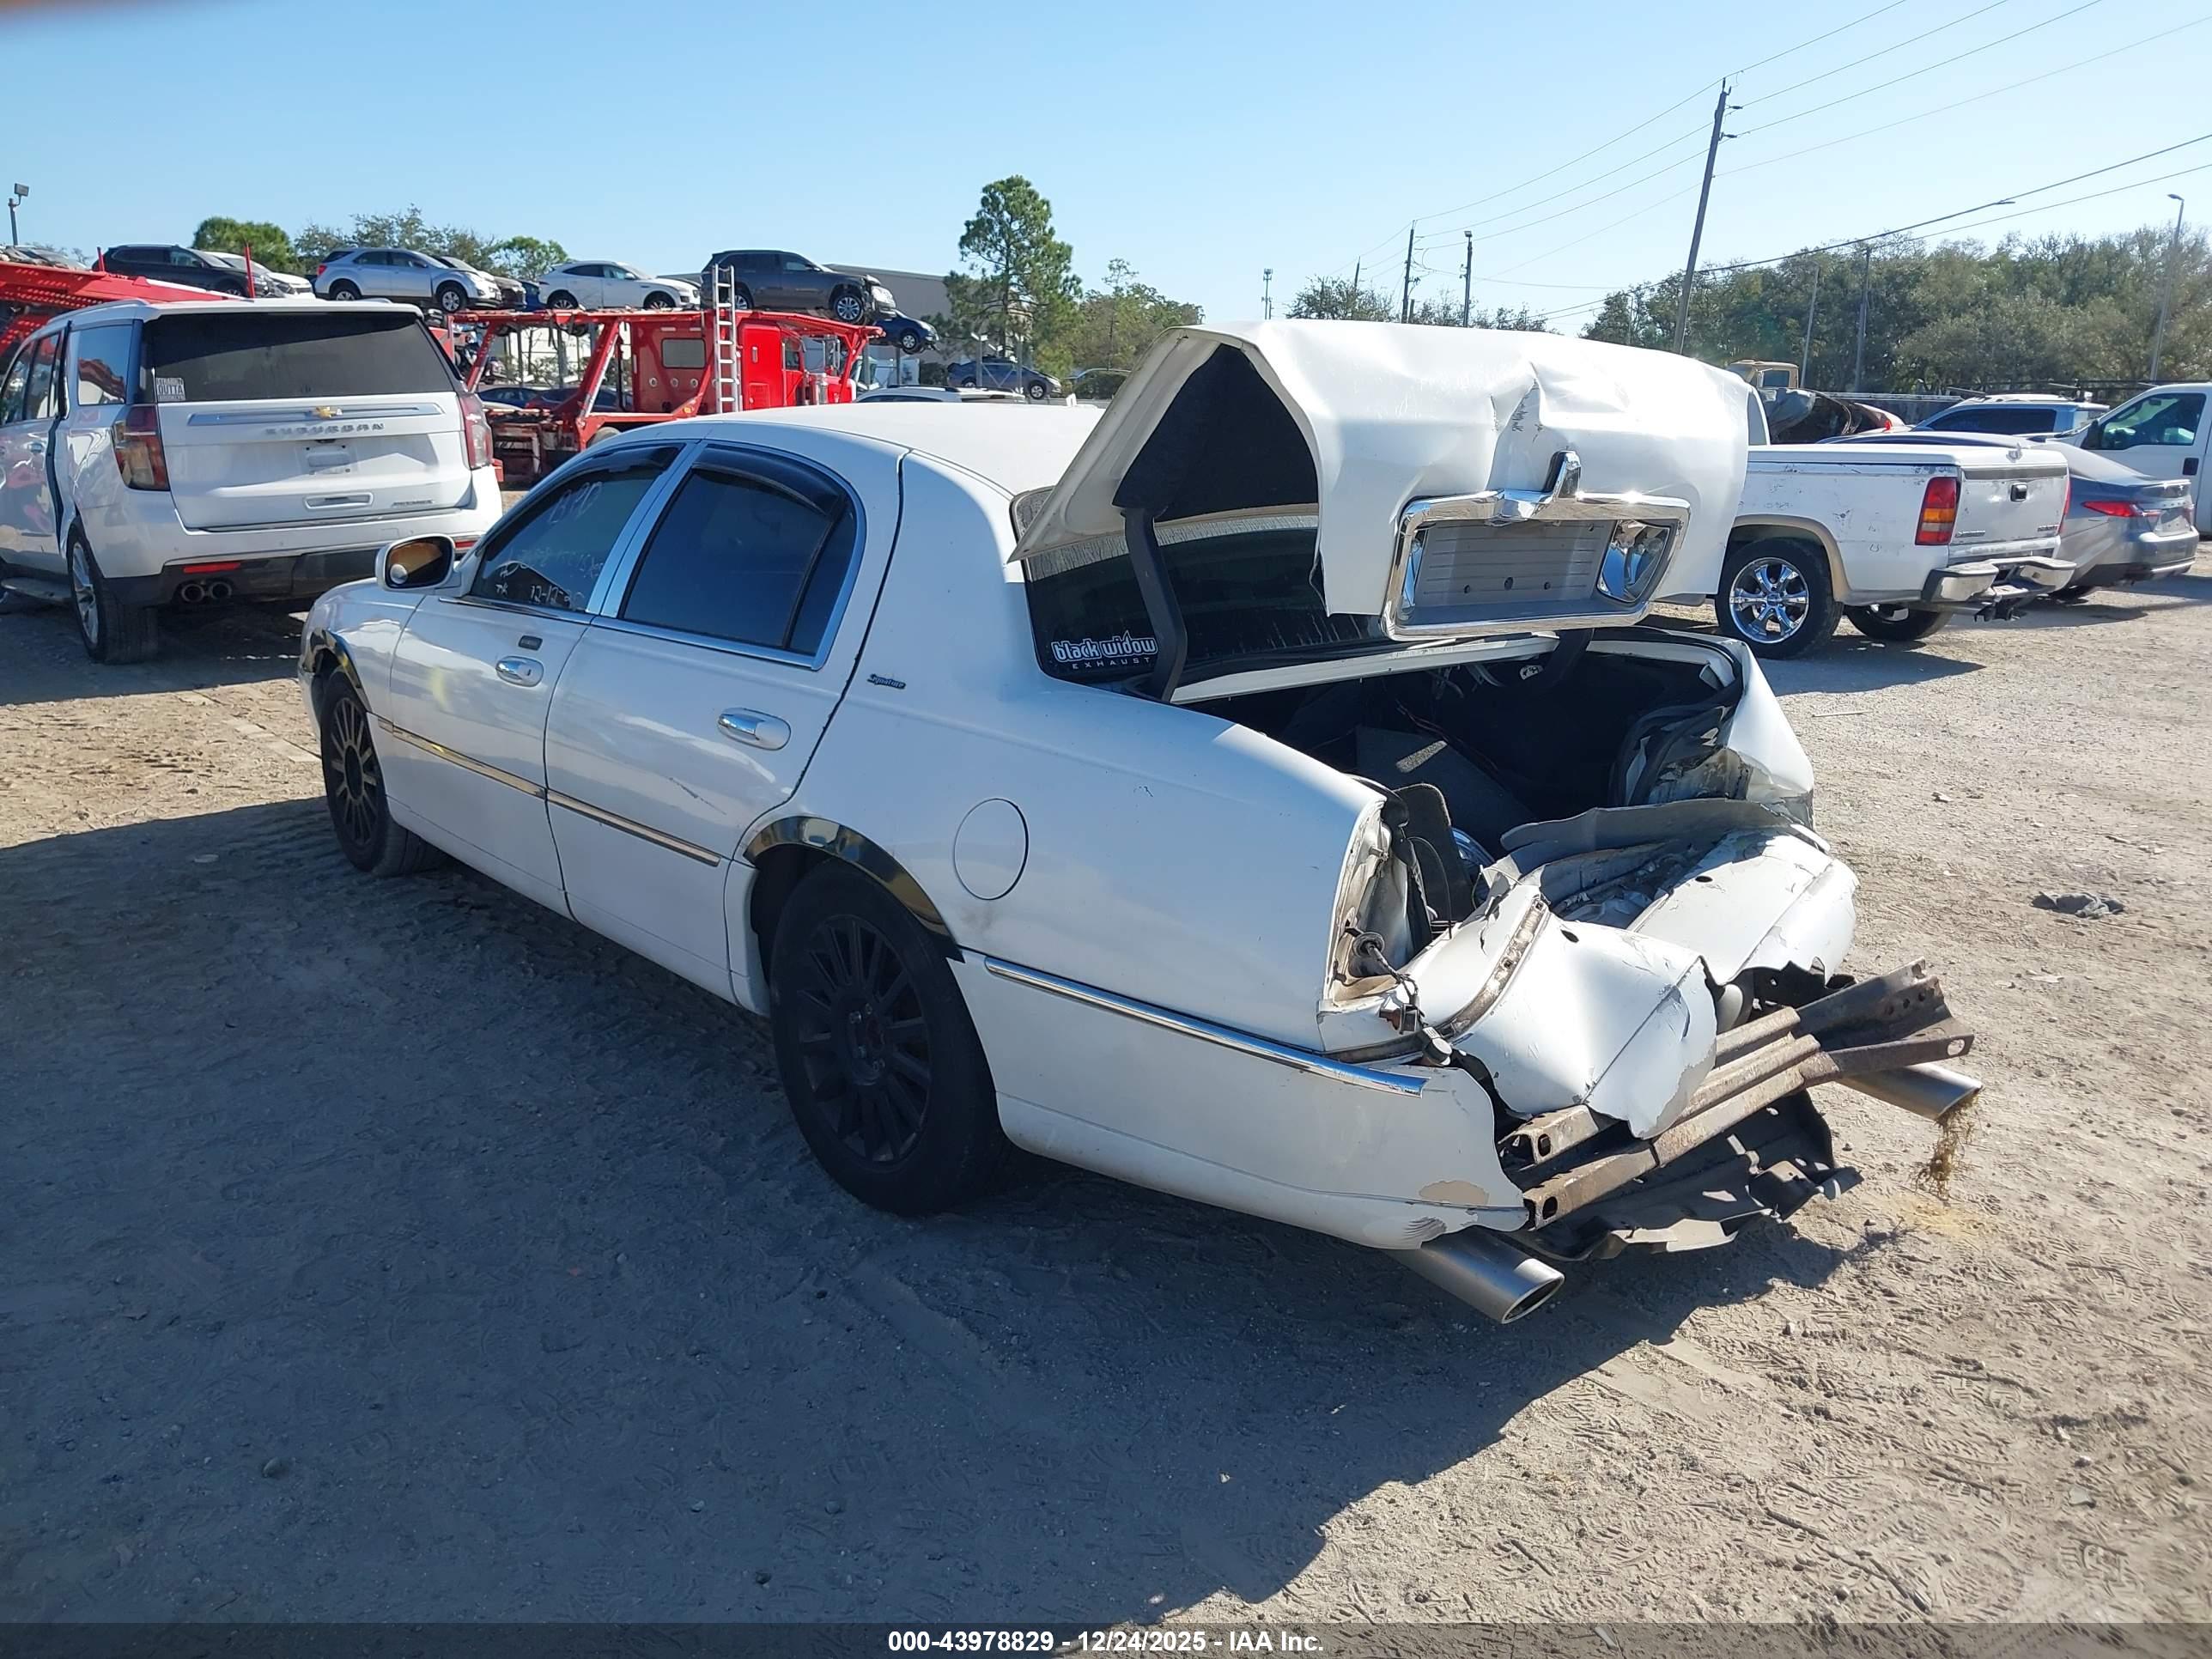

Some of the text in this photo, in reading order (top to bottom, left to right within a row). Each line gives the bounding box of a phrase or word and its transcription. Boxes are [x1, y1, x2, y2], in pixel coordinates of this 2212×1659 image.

[157, 384, 184, 395] OUTTA
[1052, 630, 1158, 662] black widow
[1073, 657, 1151, 669] EXHAUST
[867, 673, 906, 690] Signature
